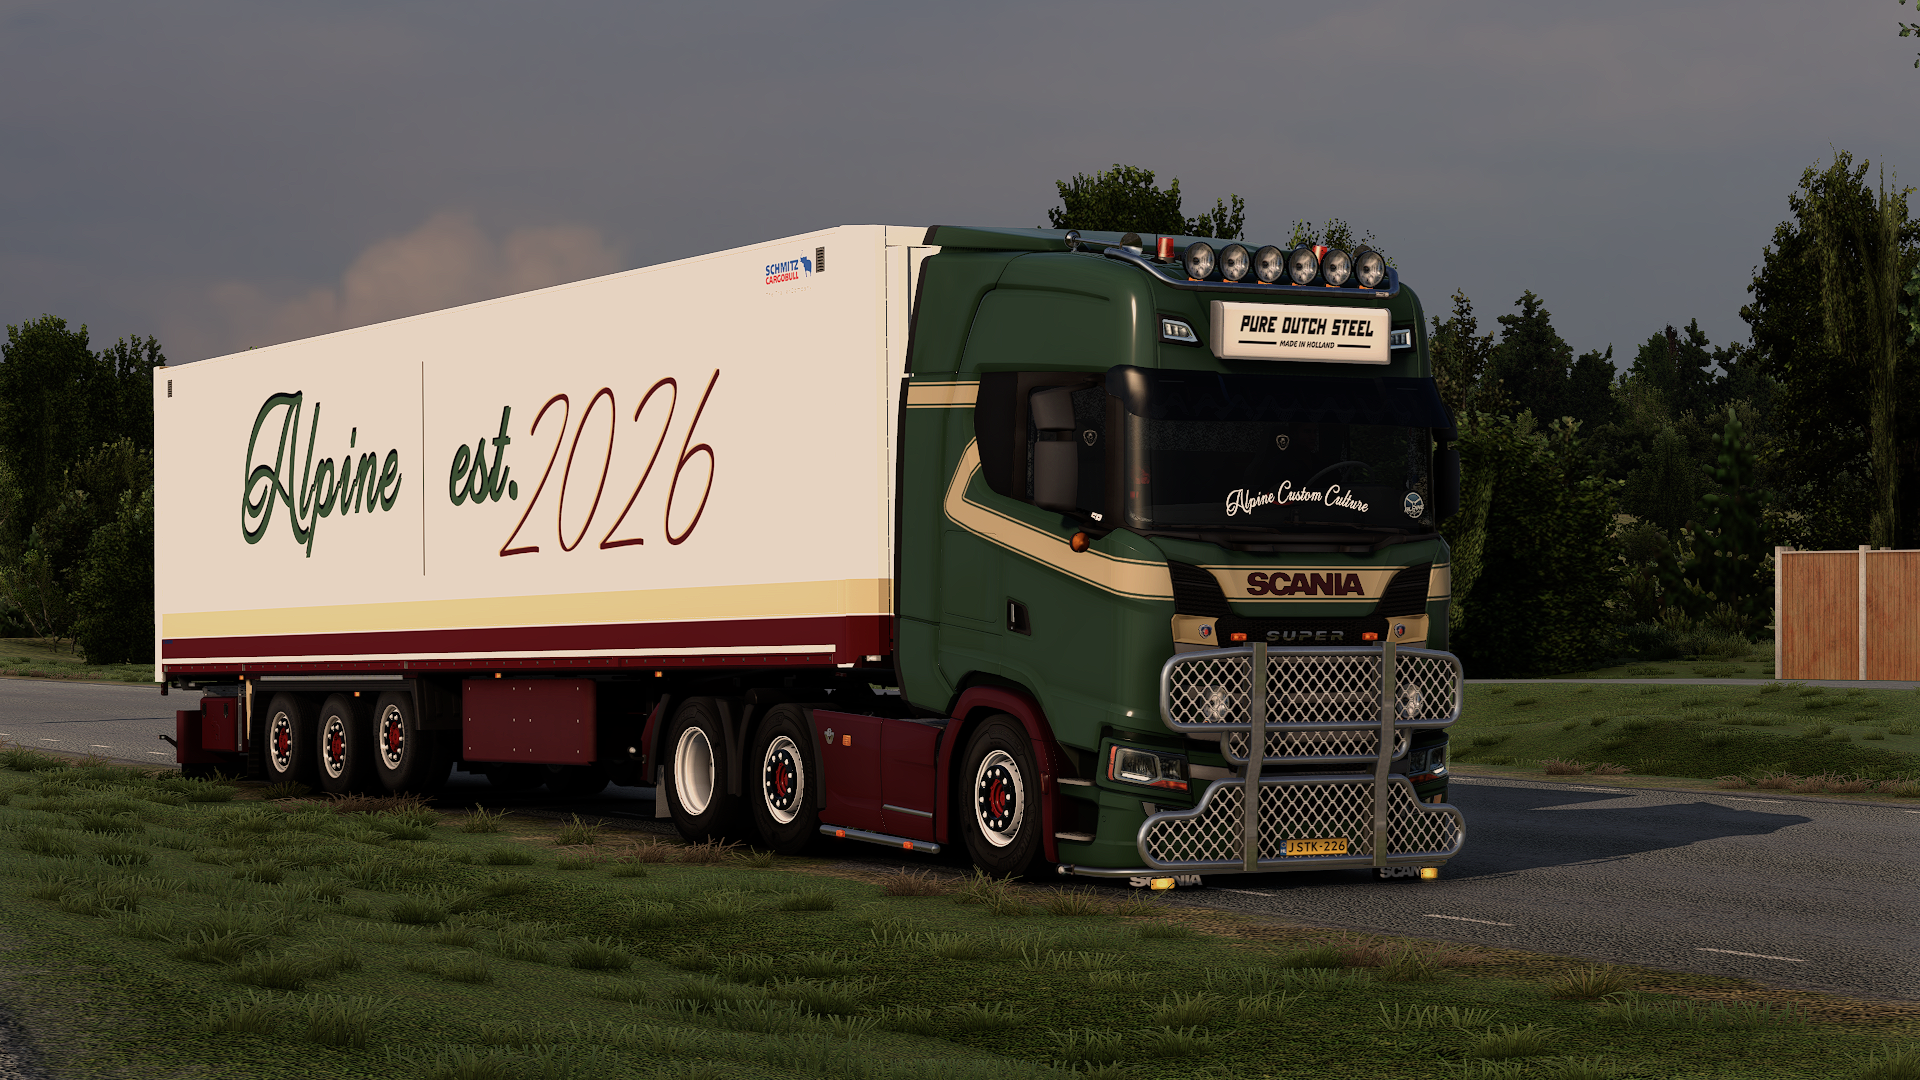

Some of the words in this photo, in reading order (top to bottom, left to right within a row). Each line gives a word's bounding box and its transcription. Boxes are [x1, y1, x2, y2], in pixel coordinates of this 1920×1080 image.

[765, 259, 799, 276] SCHMITZ
[765, 271, 799, 285] CARGOBULL
[1240, 315, 1278, 333] PURE
[1281, 317, 1327, 335] DUTCH
[1331, 319, 1374, 337] STEEL
[1279, 340, 1298, 348] MADE
[1306, 341, 1335, 349] HOLLAND
[241, 390, 402, 558] Alpine
[449, 405, 518, 506] est.
[499, 368, 720, 557] 2026
[1226, 488, 1275, 516] Alpine
[1277, 480, 1322, 504] Custom
[1324, 484, 1369, 512] Culture
[1246, 572, 1365, 596] SCANIA
[1266, 630, 1344, 641] SUPER
[1288, 840, 1346, 853] JSTK-226
[1380, 866, 1422, 878] SCAN
